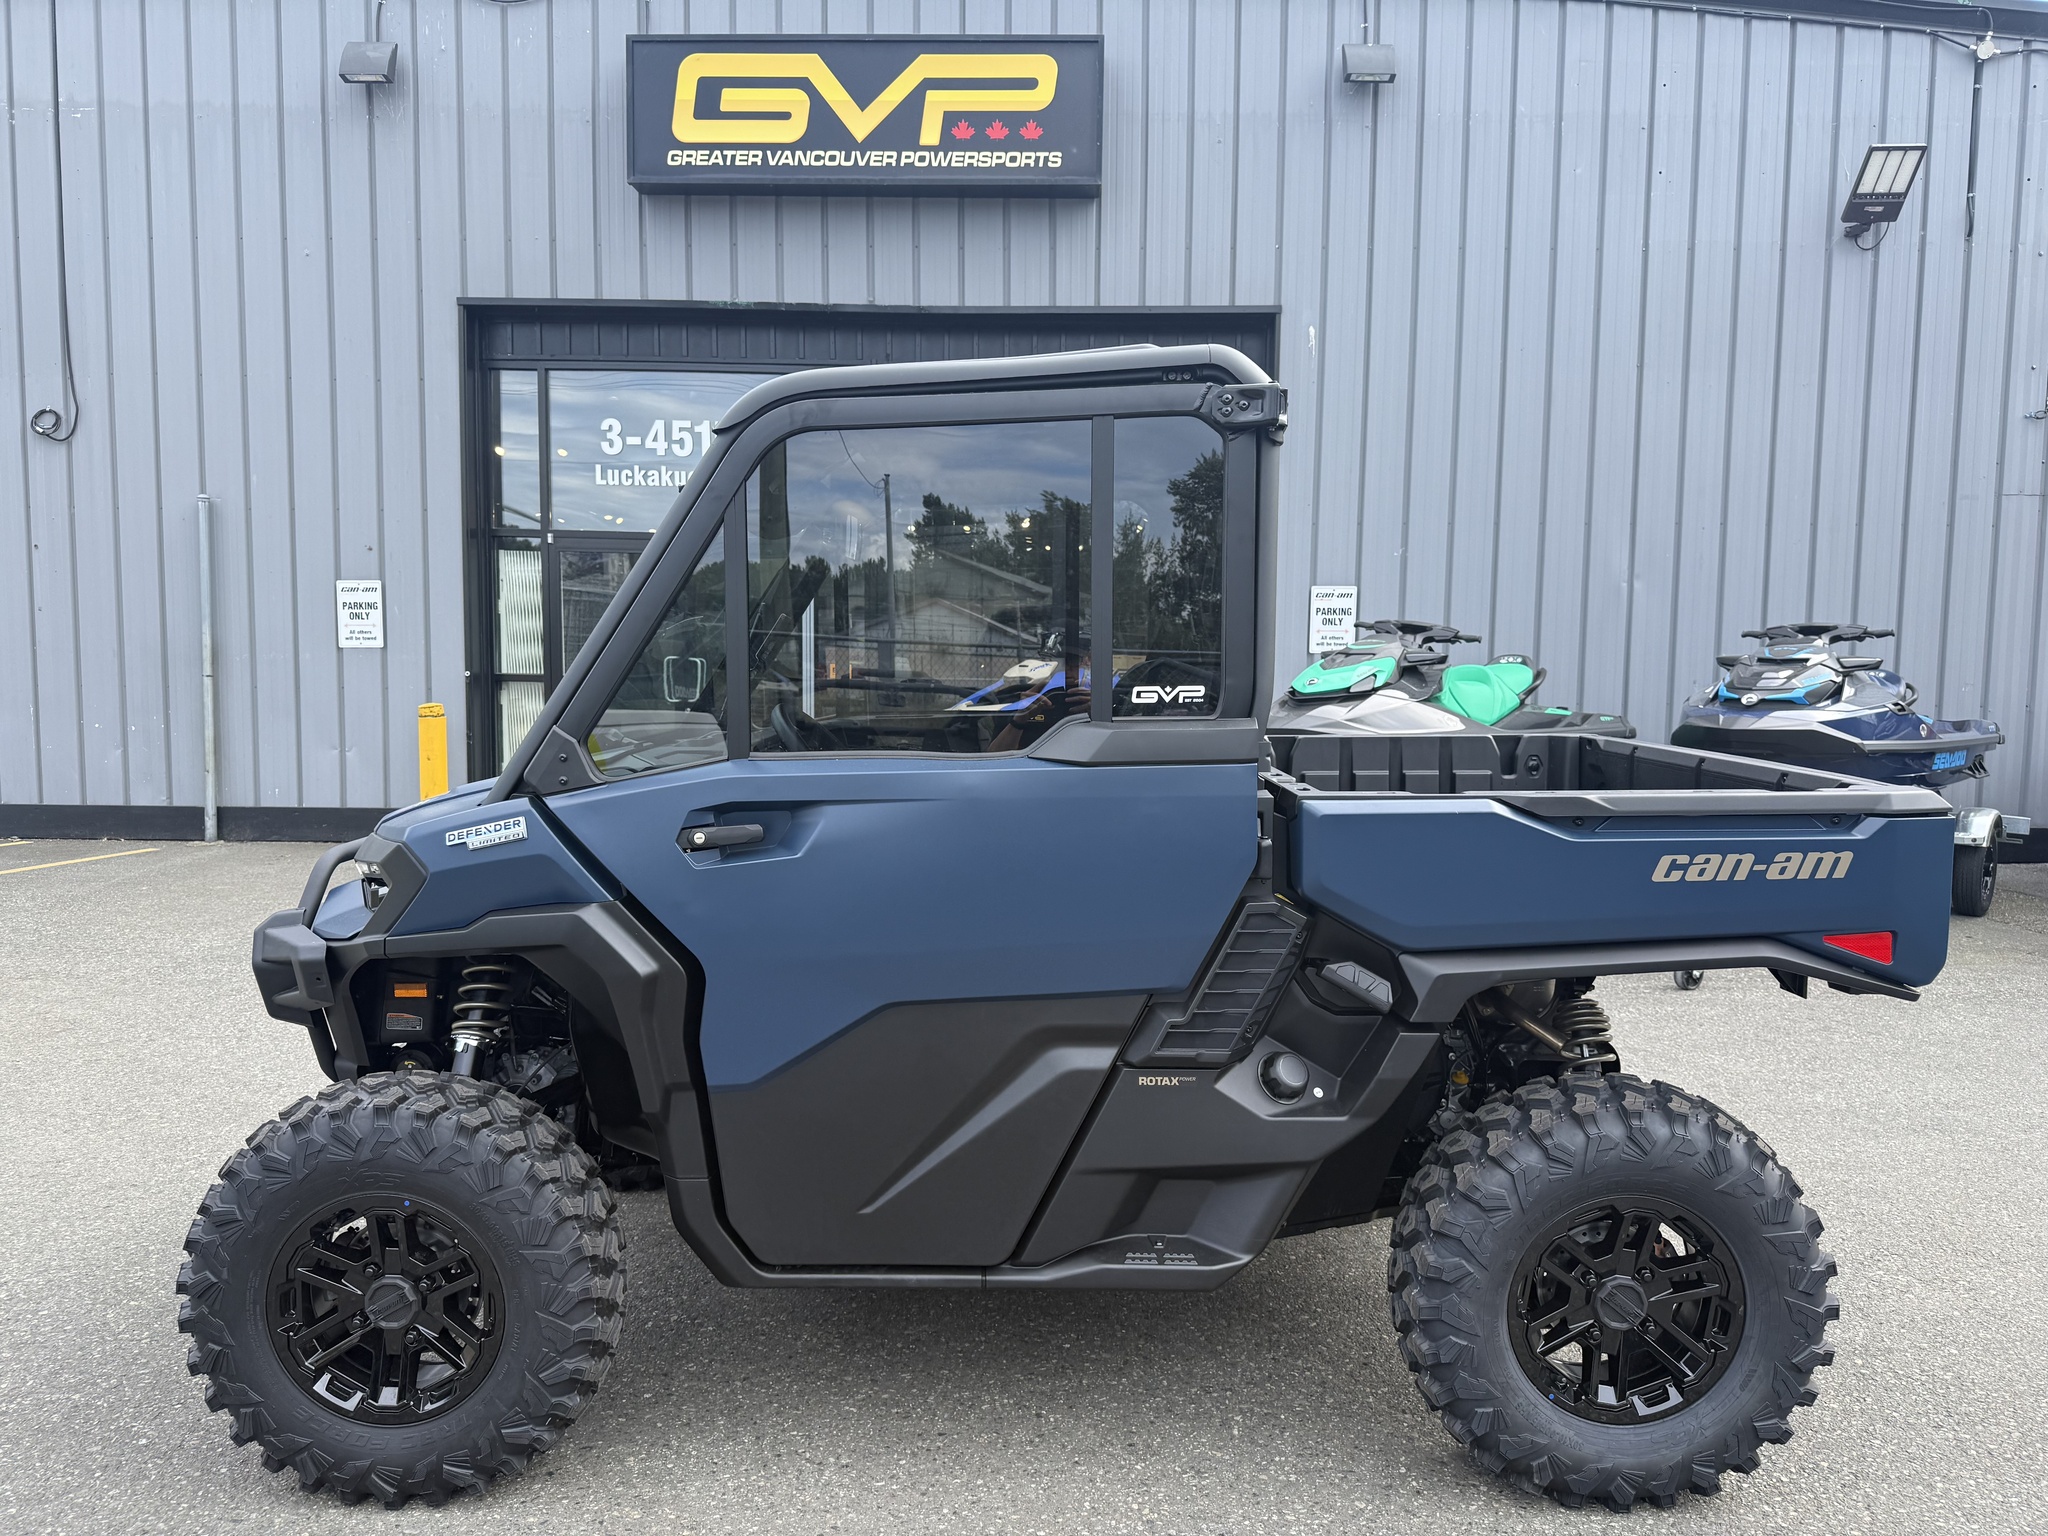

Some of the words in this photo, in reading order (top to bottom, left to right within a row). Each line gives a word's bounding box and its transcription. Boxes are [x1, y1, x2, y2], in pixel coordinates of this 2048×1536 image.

[671, 53, 1059, 146] GVP
[666, 149, 763, 167] GREATER
[767, 150, 898, 168] VANCOUVER
[899, 150, 1063, 168] POWERSPORTS
[600, 417, 718, 457] 3-451
[595, 464, 693, 487] Luckaku
[342, 601, 379, 611] PARKING
[1315, 607, 1353, 616] PARKING
[349, 611, 371, 621] ONLY
[1321, 617, 1344, 626] ONLY
[1131, 685, 1206, 704] GVP
[447, 819, 522, 843] DEFENDER
[471, 833, 520, 848] LIMITED
[1651, 850, 1854, 883] can-am
[1138, 1076, 1180, 1086] ROTAX
